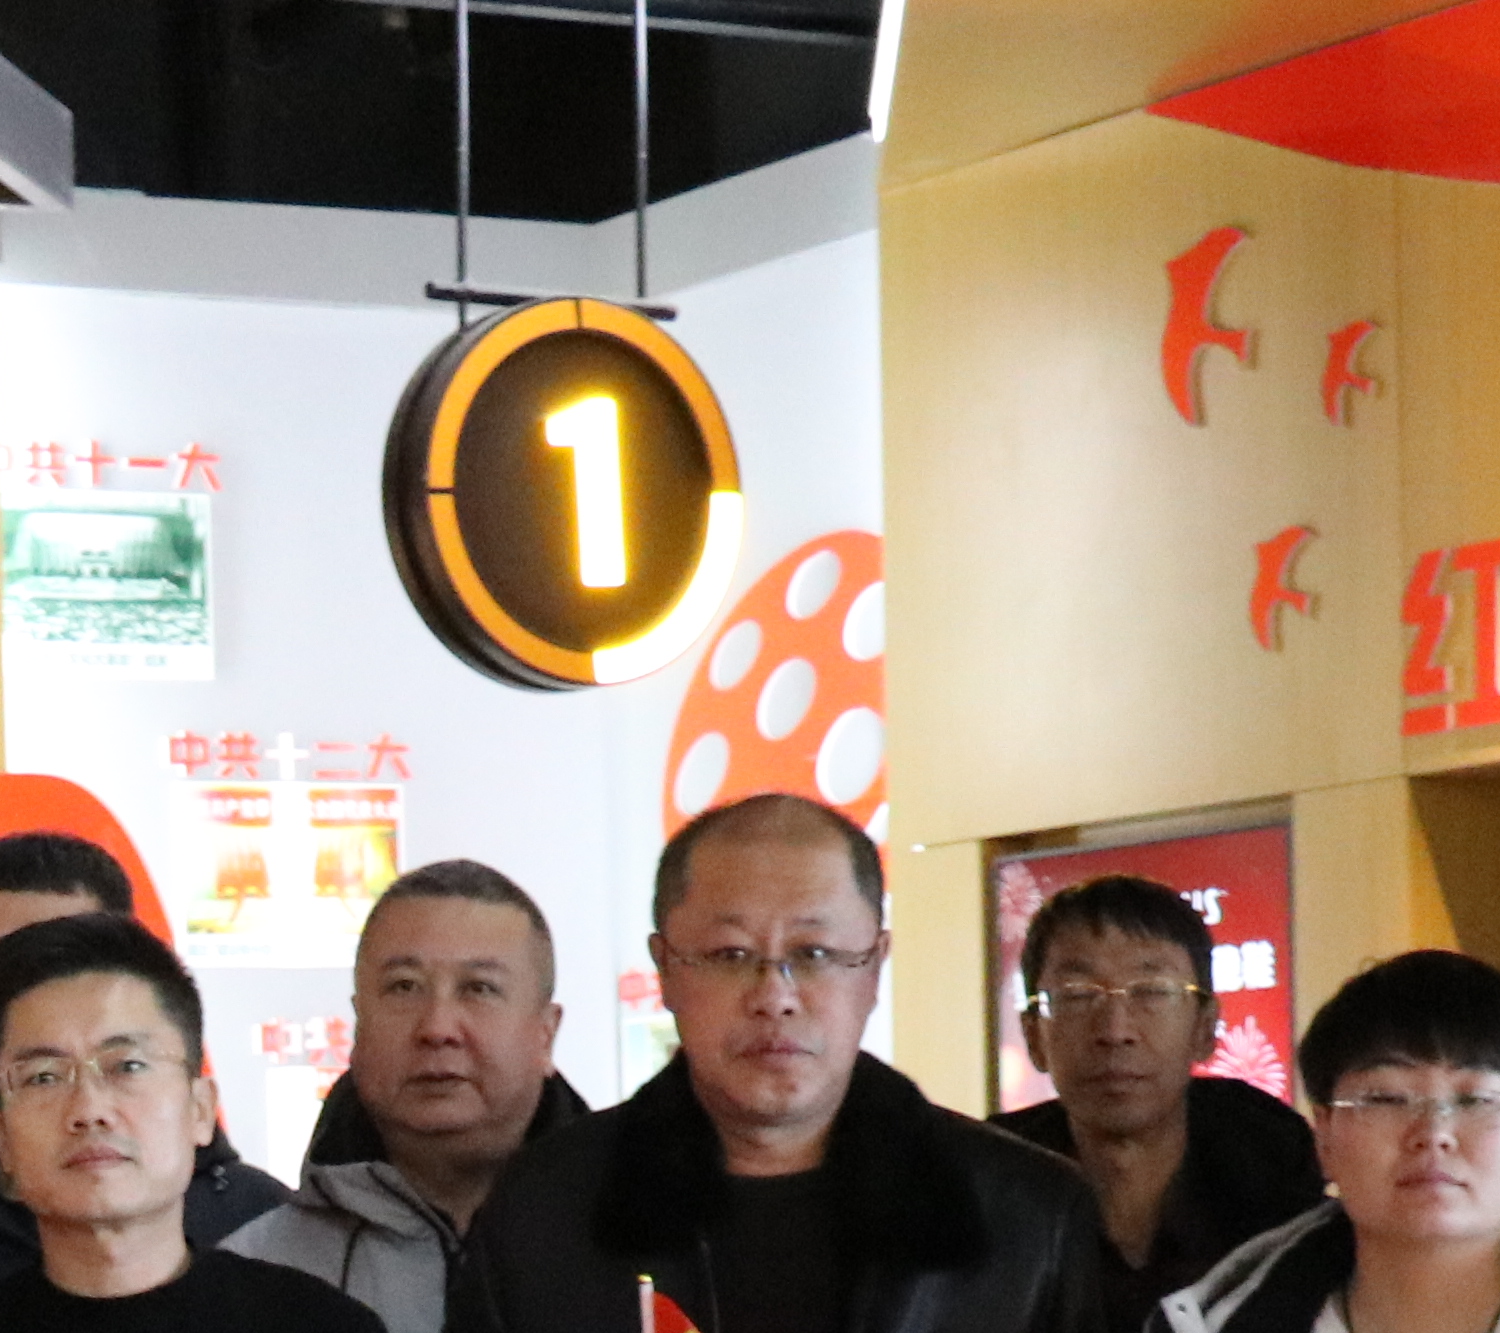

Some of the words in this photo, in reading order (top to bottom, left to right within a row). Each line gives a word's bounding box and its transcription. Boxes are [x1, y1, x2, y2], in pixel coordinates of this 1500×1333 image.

[544, 396, 628, 588] 1
[168, 729, 412, 780] 中共十二大
